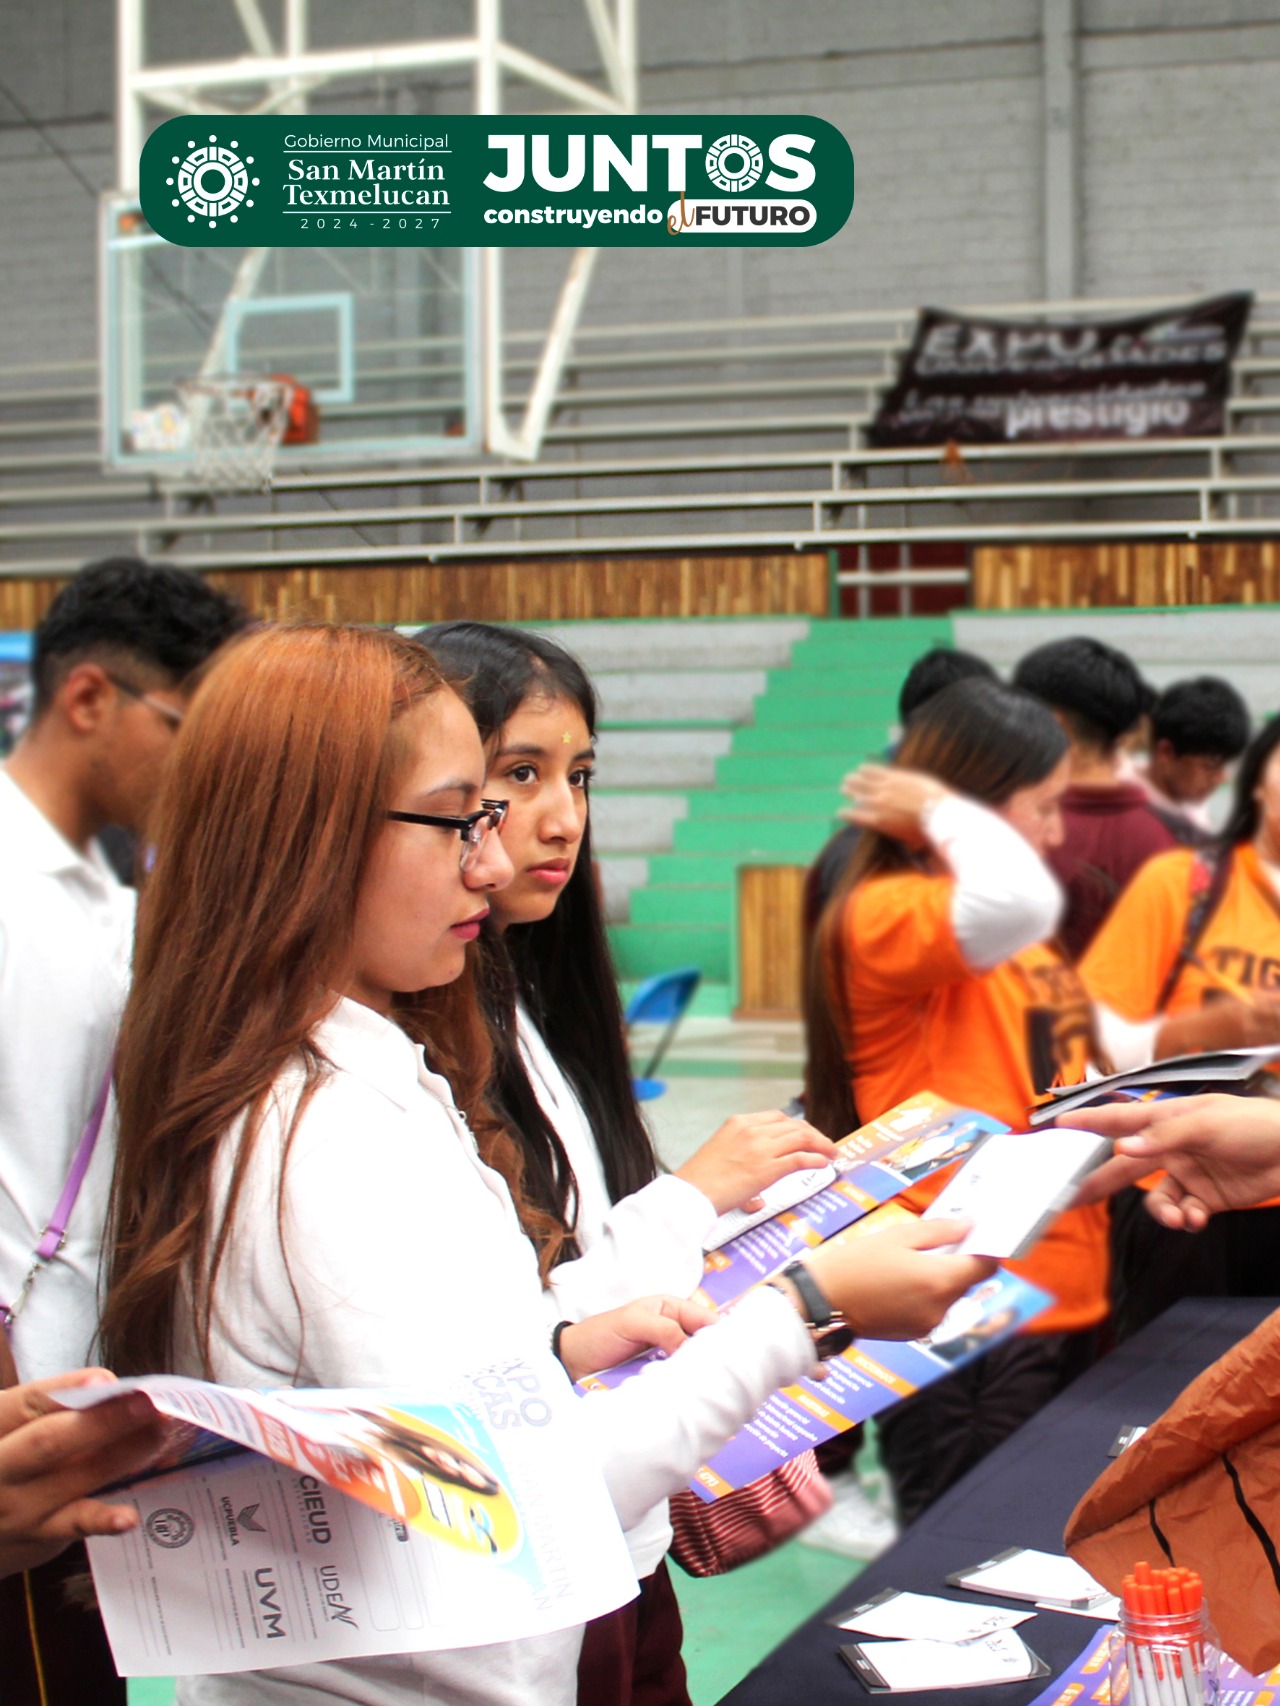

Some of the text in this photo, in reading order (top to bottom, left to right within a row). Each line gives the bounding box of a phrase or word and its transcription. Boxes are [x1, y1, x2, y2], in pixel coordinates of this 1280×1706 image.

[921, 322, 1098, 359] EXPO
[1005, 397, 1192, 439] prestigio
[220, 1495, 241, 1547] UCPUEBLA
[299, 1474, 332, 1544] CIEUD
[253, 1566, 288, 1640] UVM
